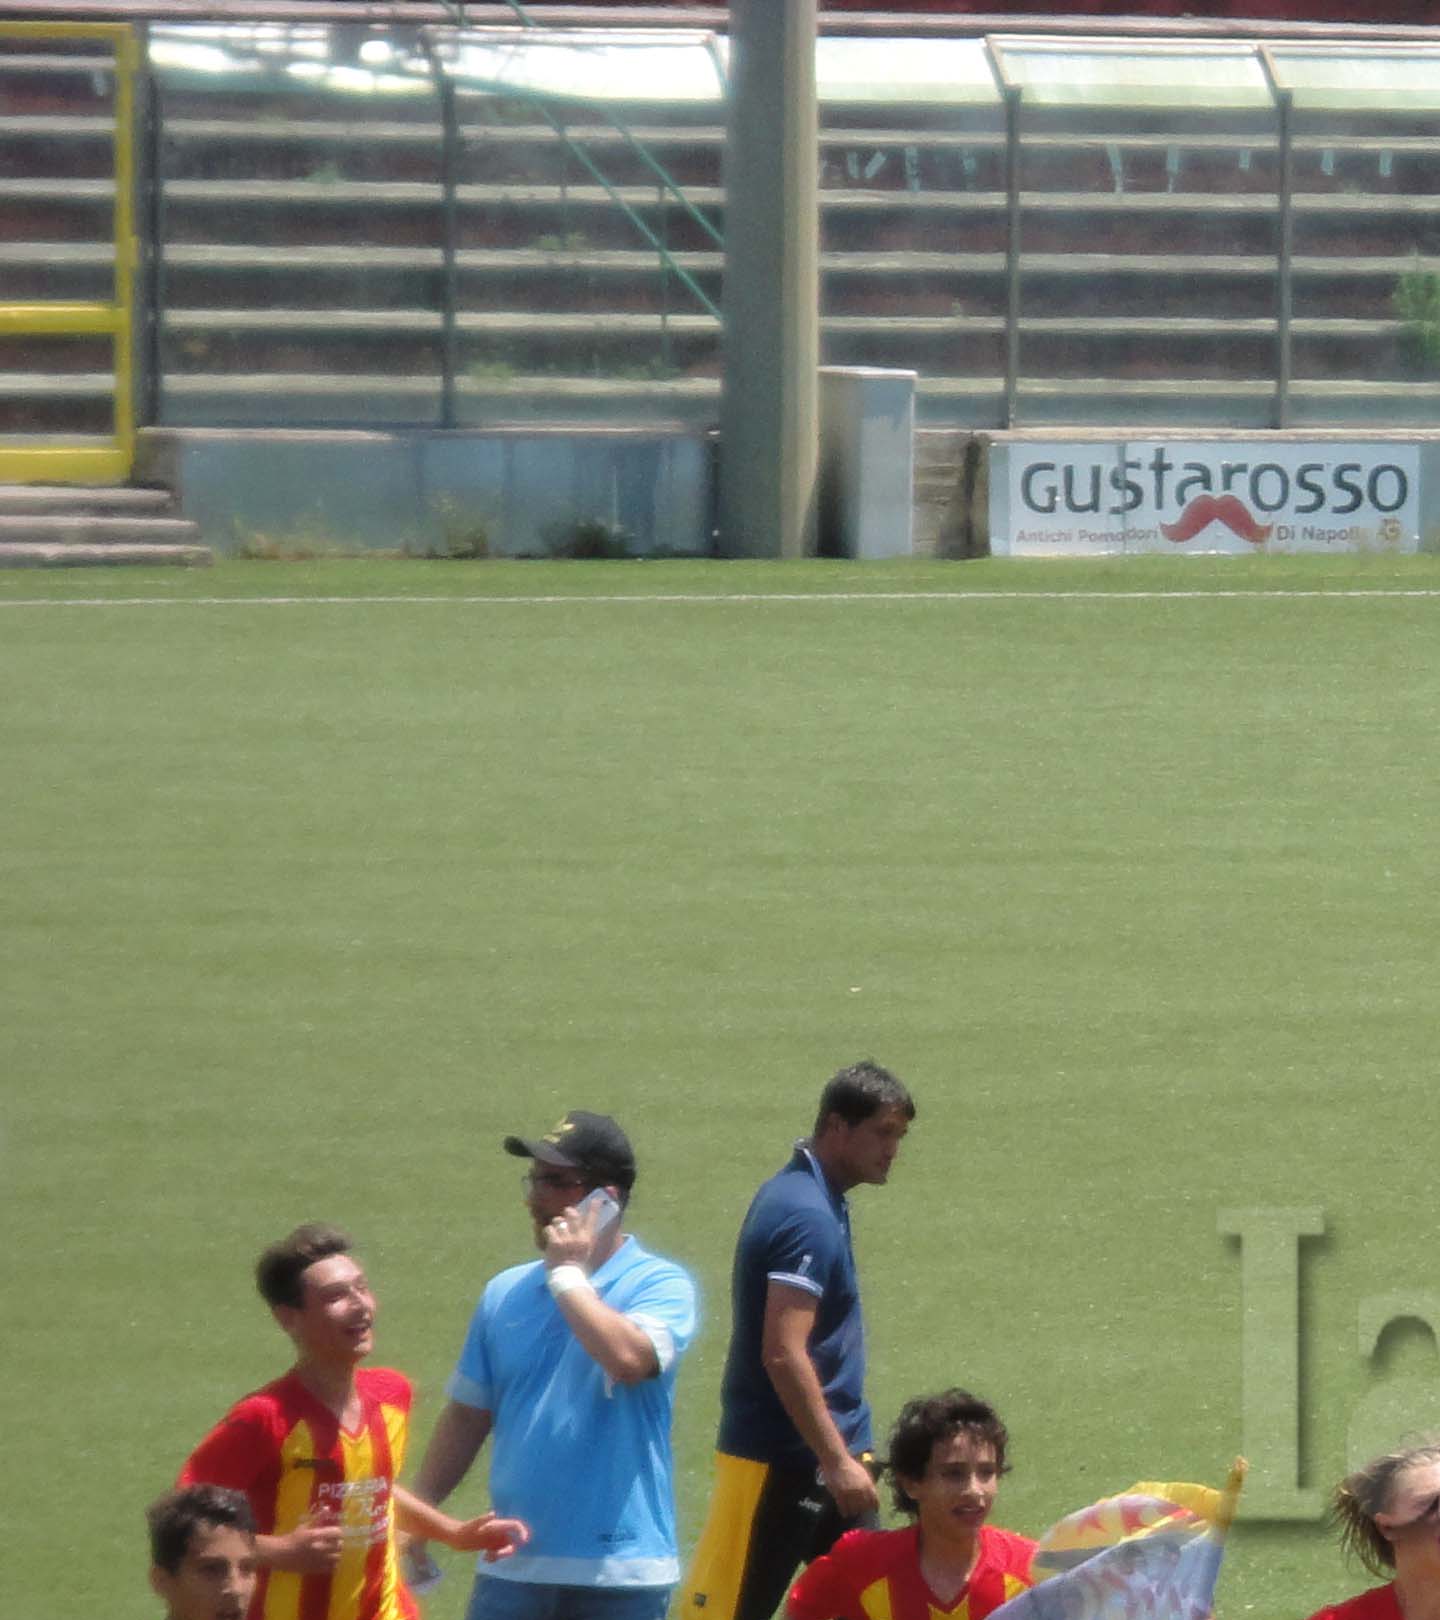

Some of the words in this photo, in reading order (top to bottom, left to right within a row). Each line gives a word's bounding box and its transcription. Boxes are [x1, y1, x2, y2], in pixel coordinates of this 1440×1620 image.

[1020, 447, 1409, 516] Gustarosso
[1016, 528, 1072, 543] Antichi
[1078, 528, 1158, 543] Pomodori
[1276, 526, 1296, 541] Di
